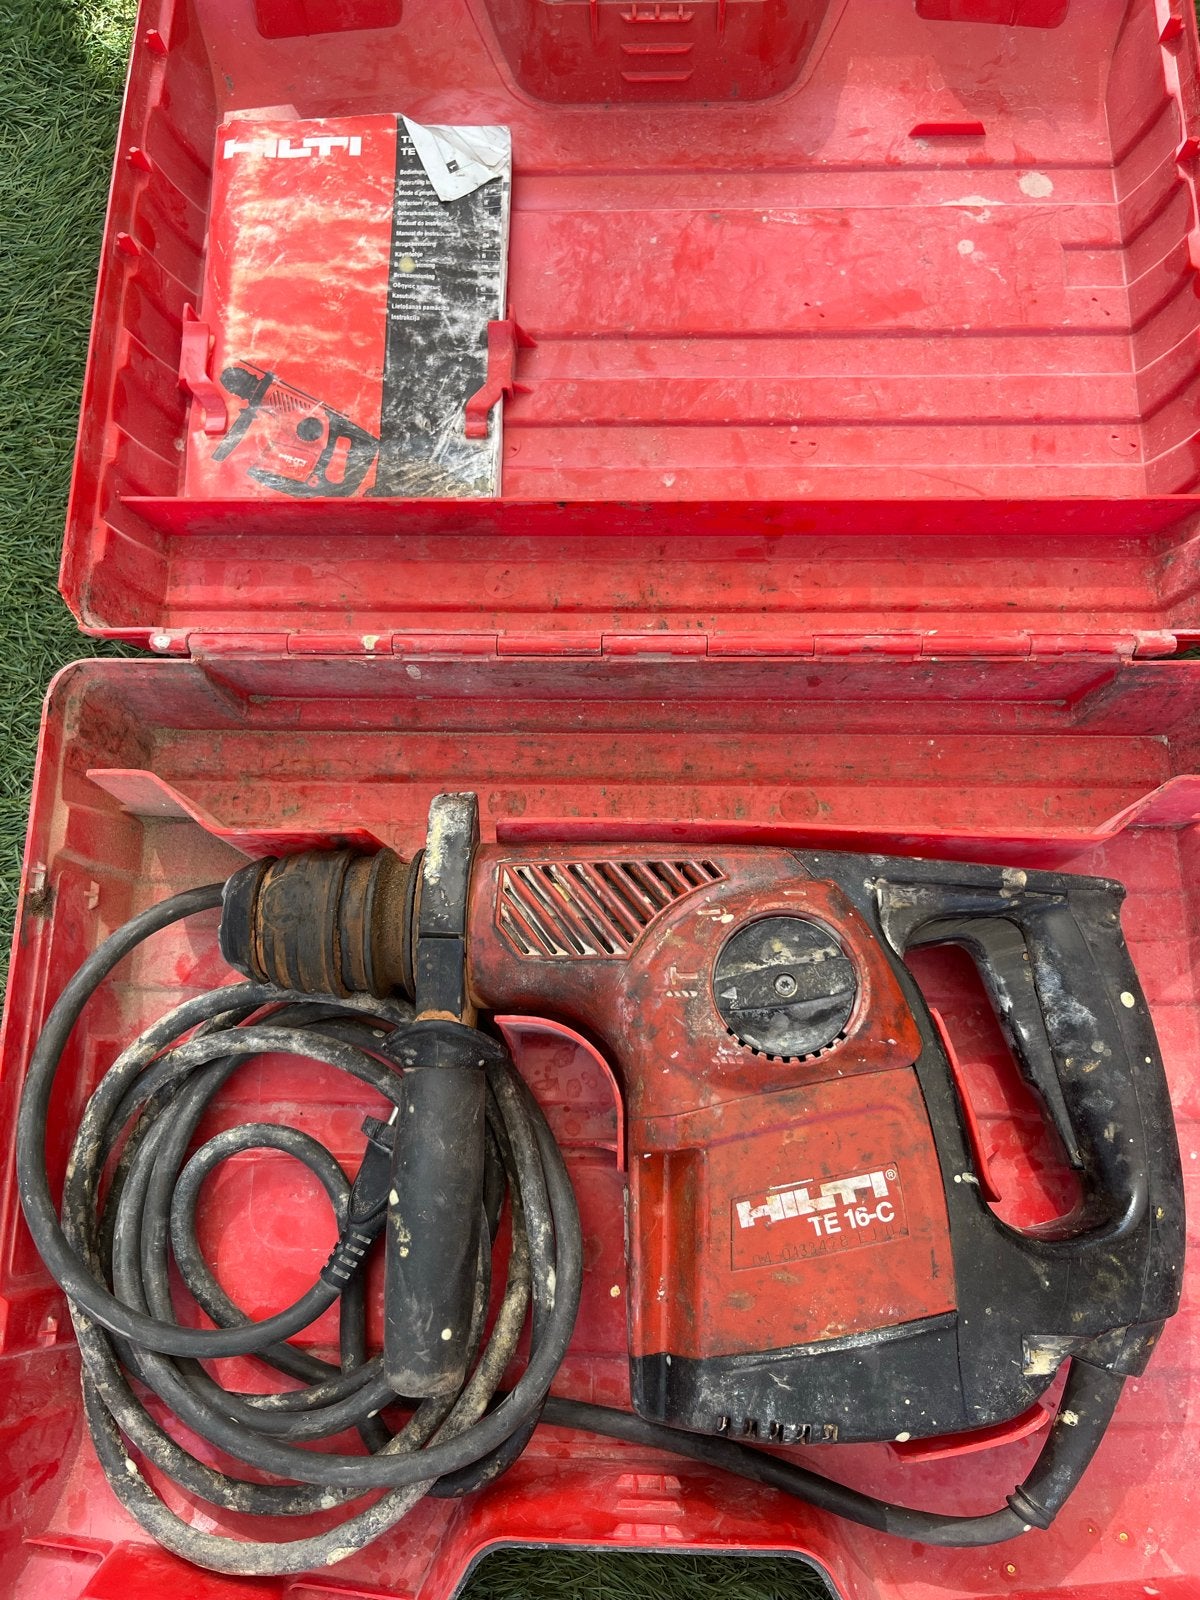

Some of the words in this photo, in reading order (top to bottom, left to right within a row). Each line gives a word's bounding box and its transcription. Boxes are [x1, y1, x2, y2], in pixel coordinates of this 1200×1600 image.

[223, 136, 362, 159] HILTI
[807, 1211, 842, 1237] TE
[843, 1201, 895, 1230] 16-C
